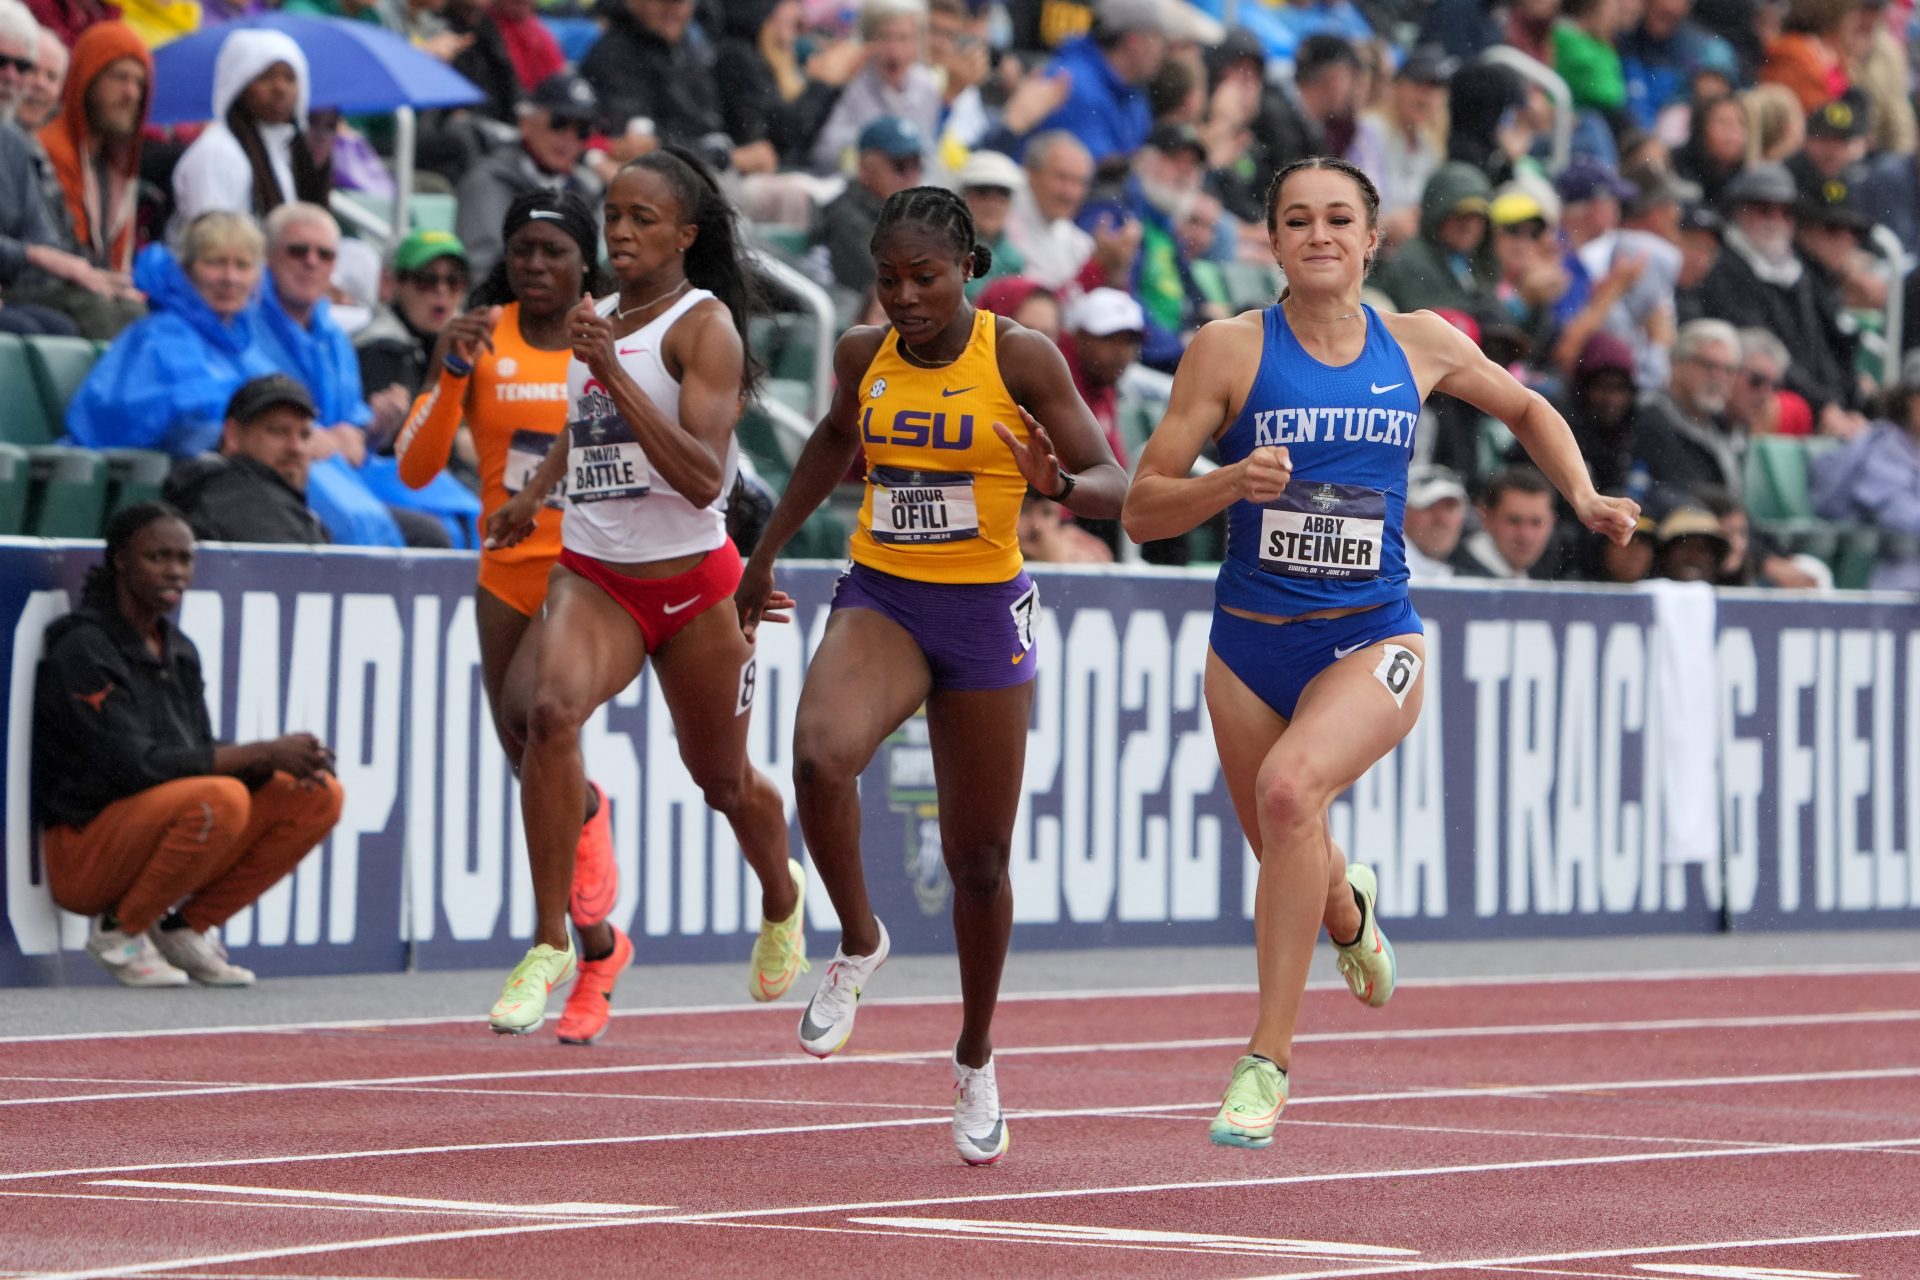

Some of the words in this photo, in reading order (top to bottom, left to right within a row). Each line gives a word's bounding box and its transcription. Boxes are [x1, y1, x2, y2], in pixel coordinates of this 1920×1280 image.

[863, 407, 974, 451] LSU
[1254, 407, 1418, 449] KENTUCKY
[583, 446, 621, 463] ANAVIA
[576, 462, 635, 489] BATTLE
[891, 489, 944, 504] FAVOUR
[892, 504, 949, 530] OFILI
[1303, 516, 1345, 535] ABBY
[1268, 530, 1373, 566] STEINER
[1015, 592, 1034, 644] 7
[741, 659, 756, 707] 8
[1386, 650, 1415, 695] 6
[1012, 607, 1222, 924] 2022
[1778, 627, 1920, 912] FIEL
